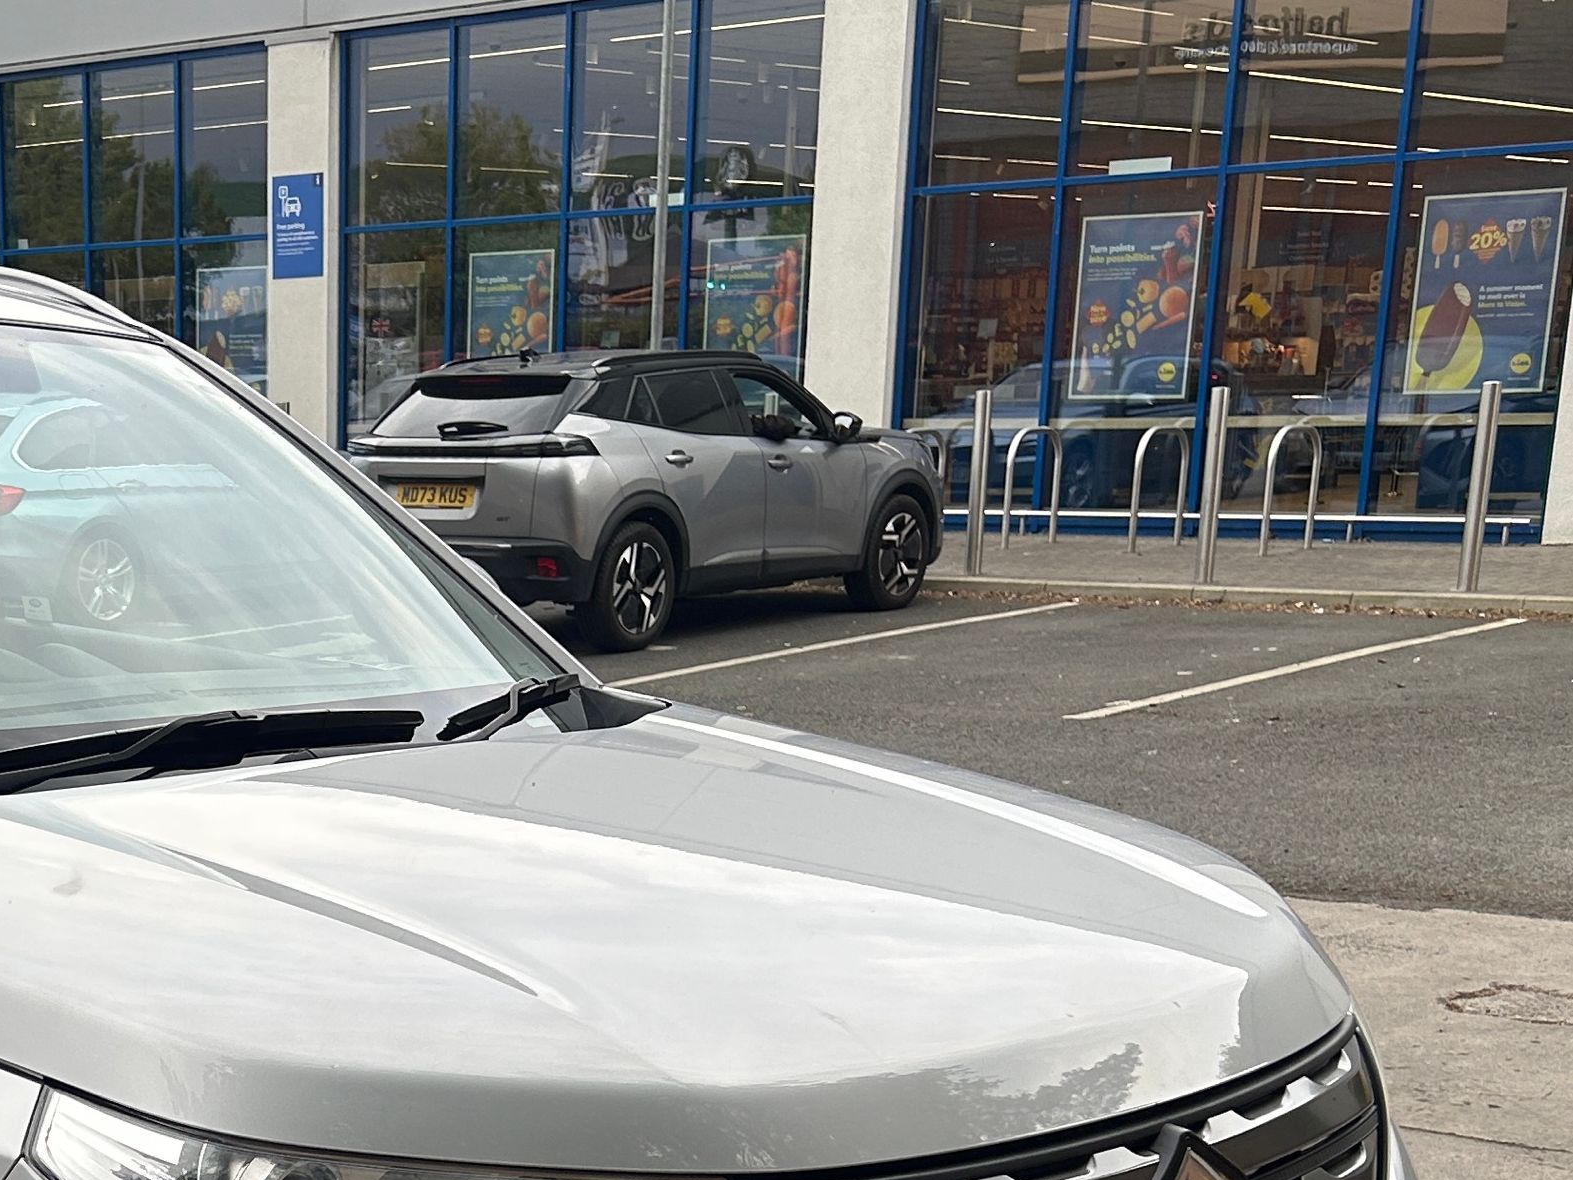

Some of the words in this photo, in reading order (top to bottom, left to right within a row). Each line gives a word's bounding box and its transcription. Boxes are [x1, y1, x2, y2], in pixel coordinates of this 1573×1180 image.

[1089, 244, 1108, 254] Turn
[1109, 243, 1135, 255] points
[1469, 230, 1508, 250] 20%
[438, 486, 468, 504] KUS
